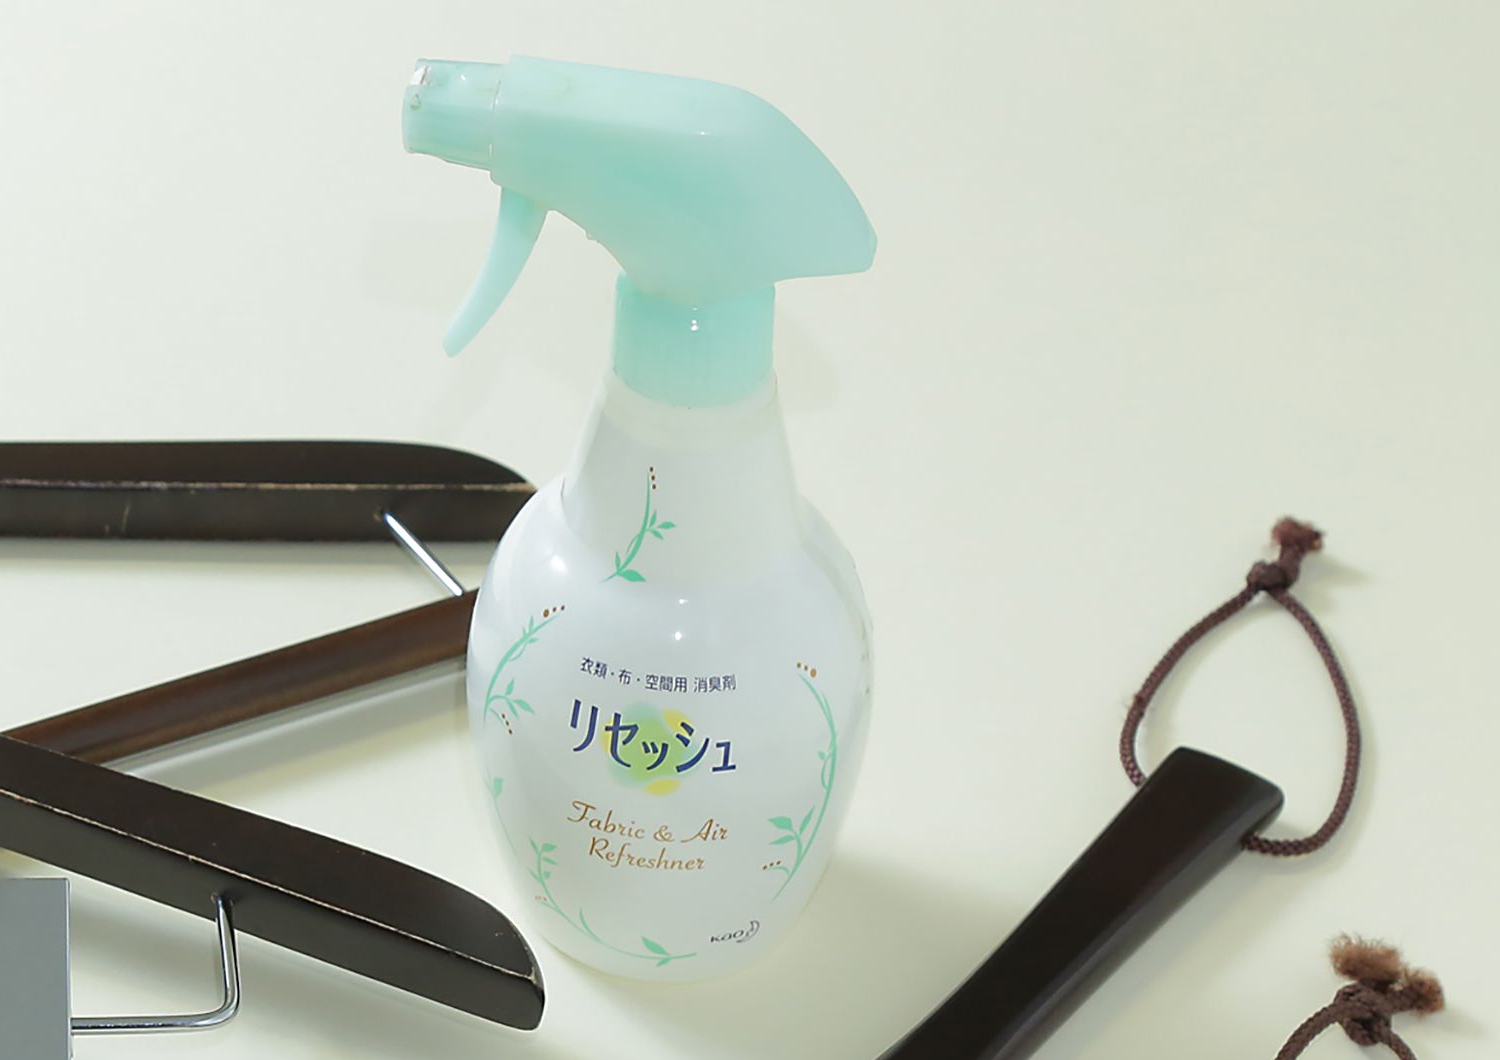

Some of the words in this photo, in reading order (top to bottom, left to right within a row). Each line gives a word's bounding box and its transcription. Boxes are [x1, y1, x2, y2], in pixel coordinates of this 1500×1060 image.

[693, 674, 737, 693] 消臭剤
[569, 699, 737, 773] リセッシュ
[566, 800, 645, 839] Fabric
[653, 824, 675, 843] &
[680, 818, 731, 843] Air
[588, 836, 706, 871] Refreshner
